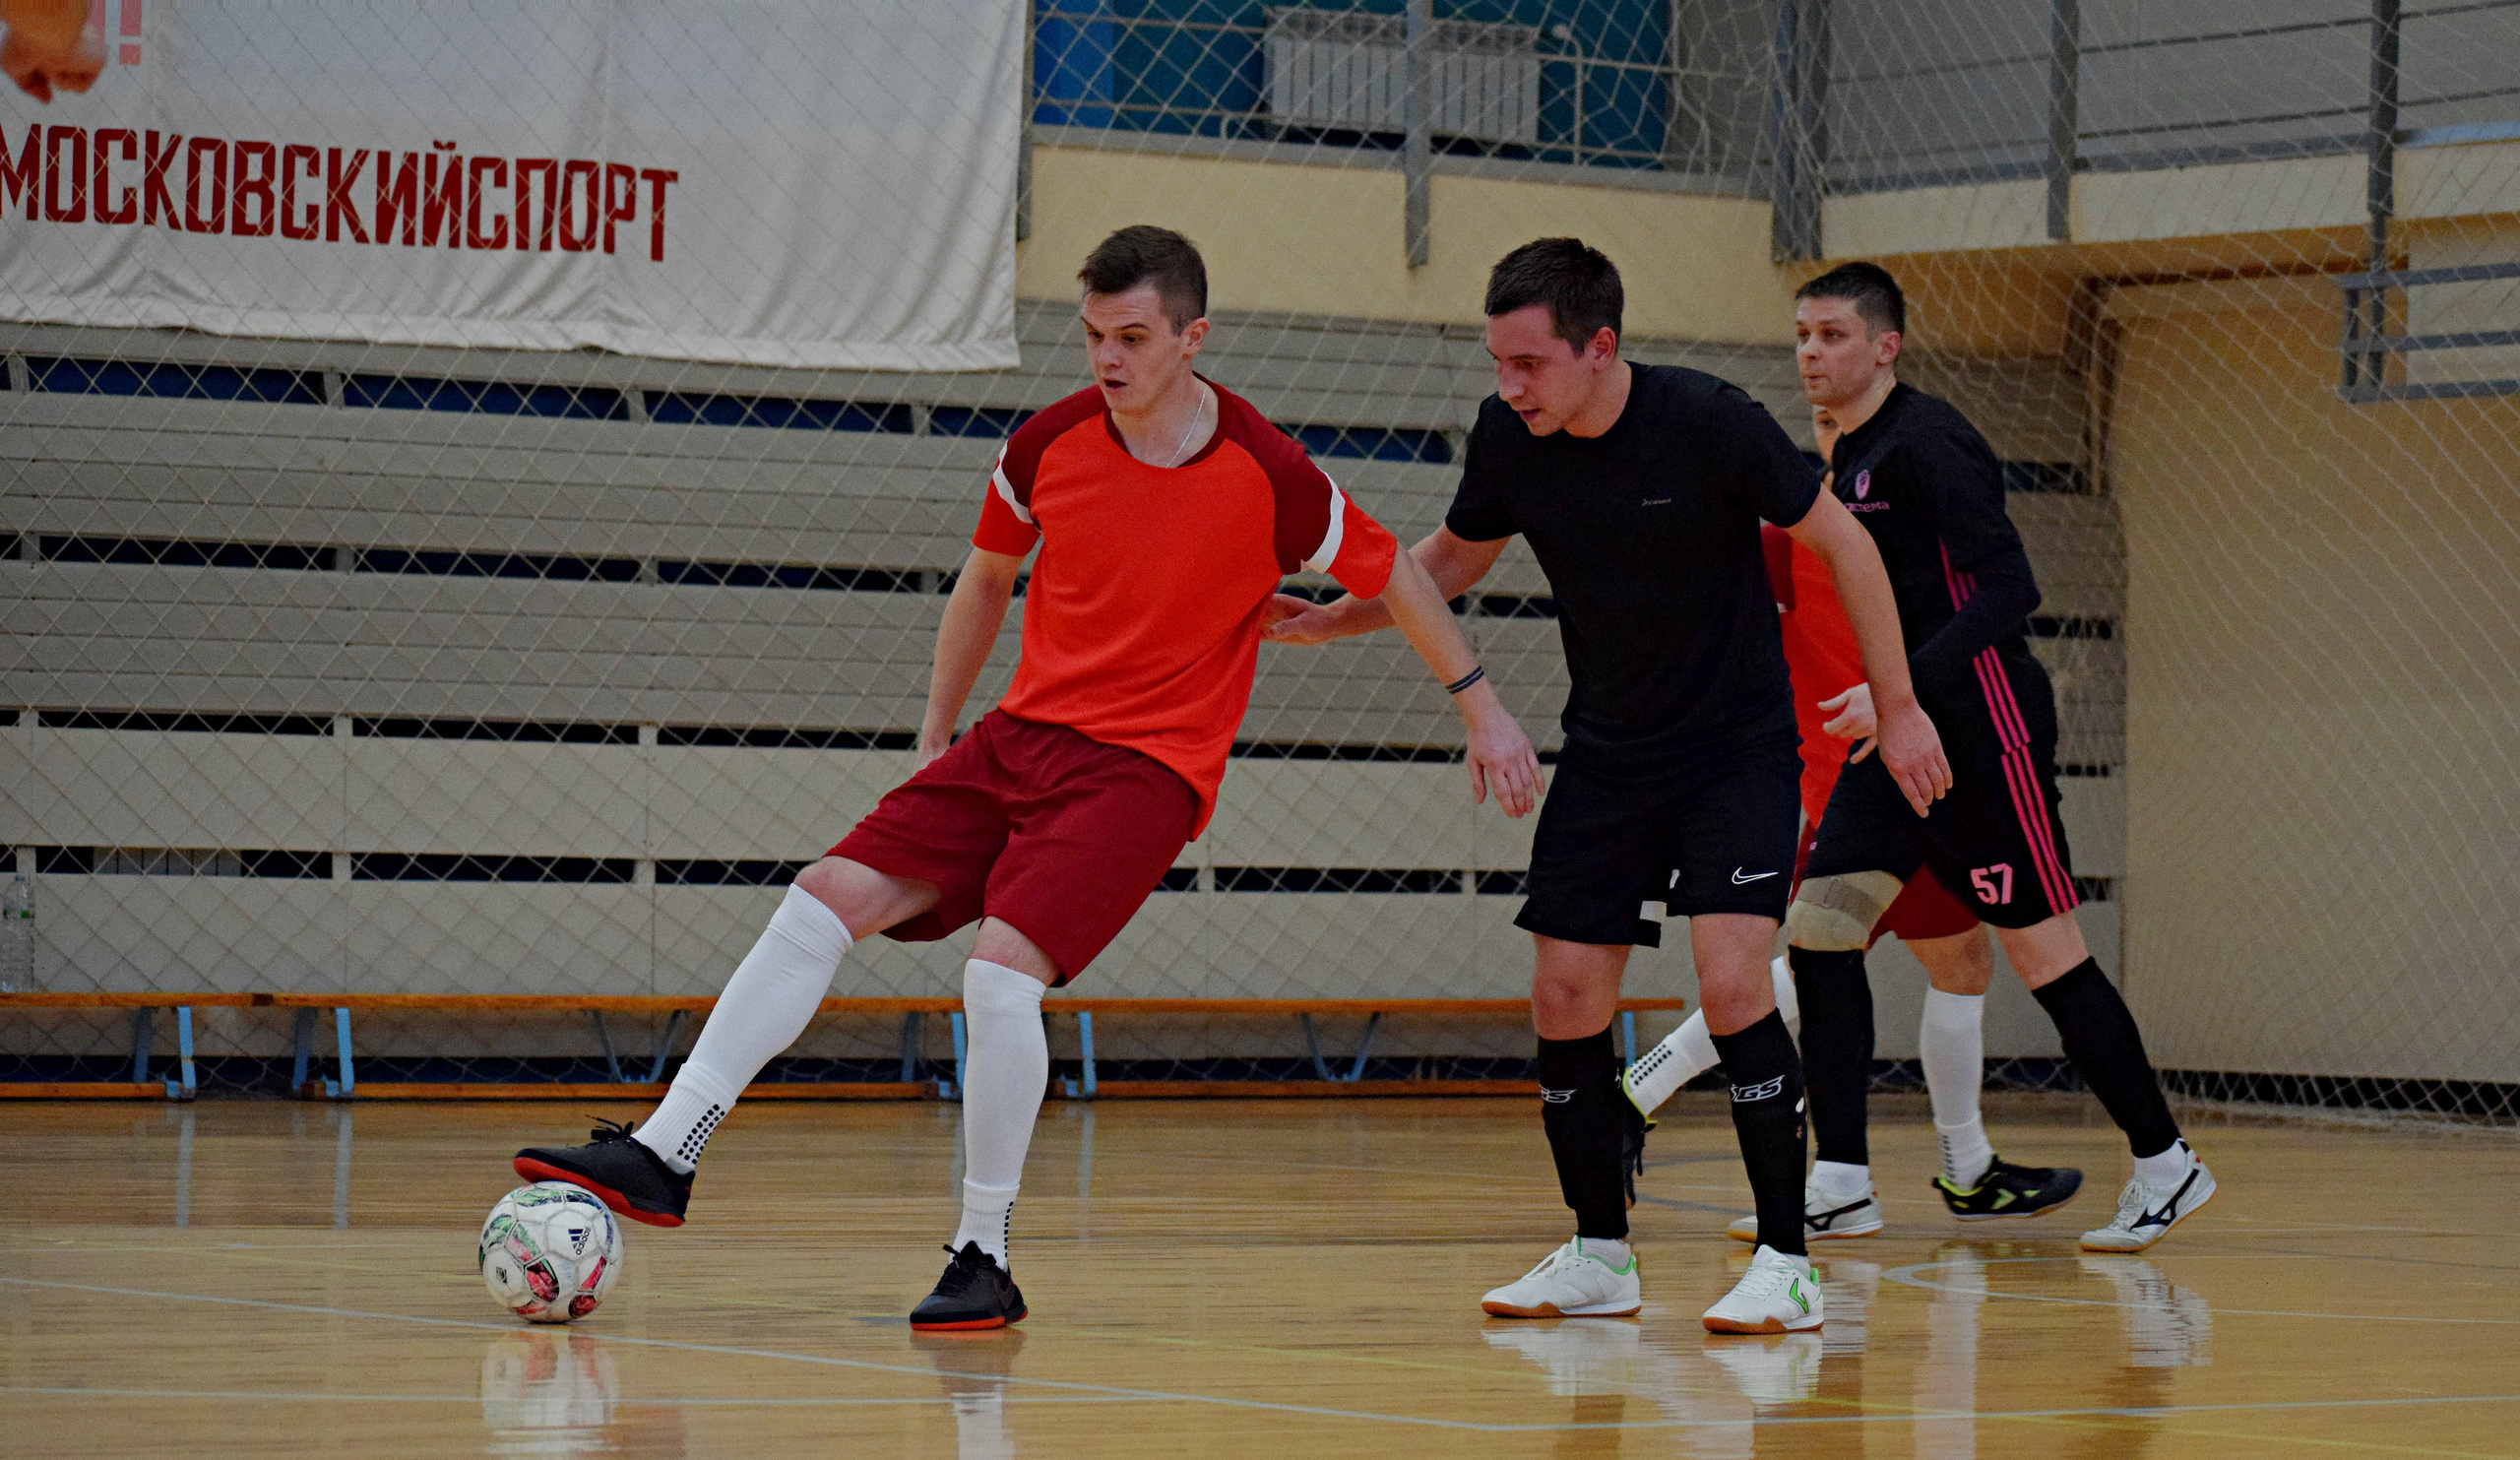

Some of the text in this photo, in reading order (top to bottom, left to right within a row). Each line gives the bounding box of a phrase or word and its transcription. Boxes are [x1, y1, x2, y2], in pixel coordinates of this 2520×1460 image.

[0, 123, 679, 263] МОСКОВСКИЙСПОРТ
[1970, 862, 2014, 905] 57
[575, 1226, 592, 1256] adidas
